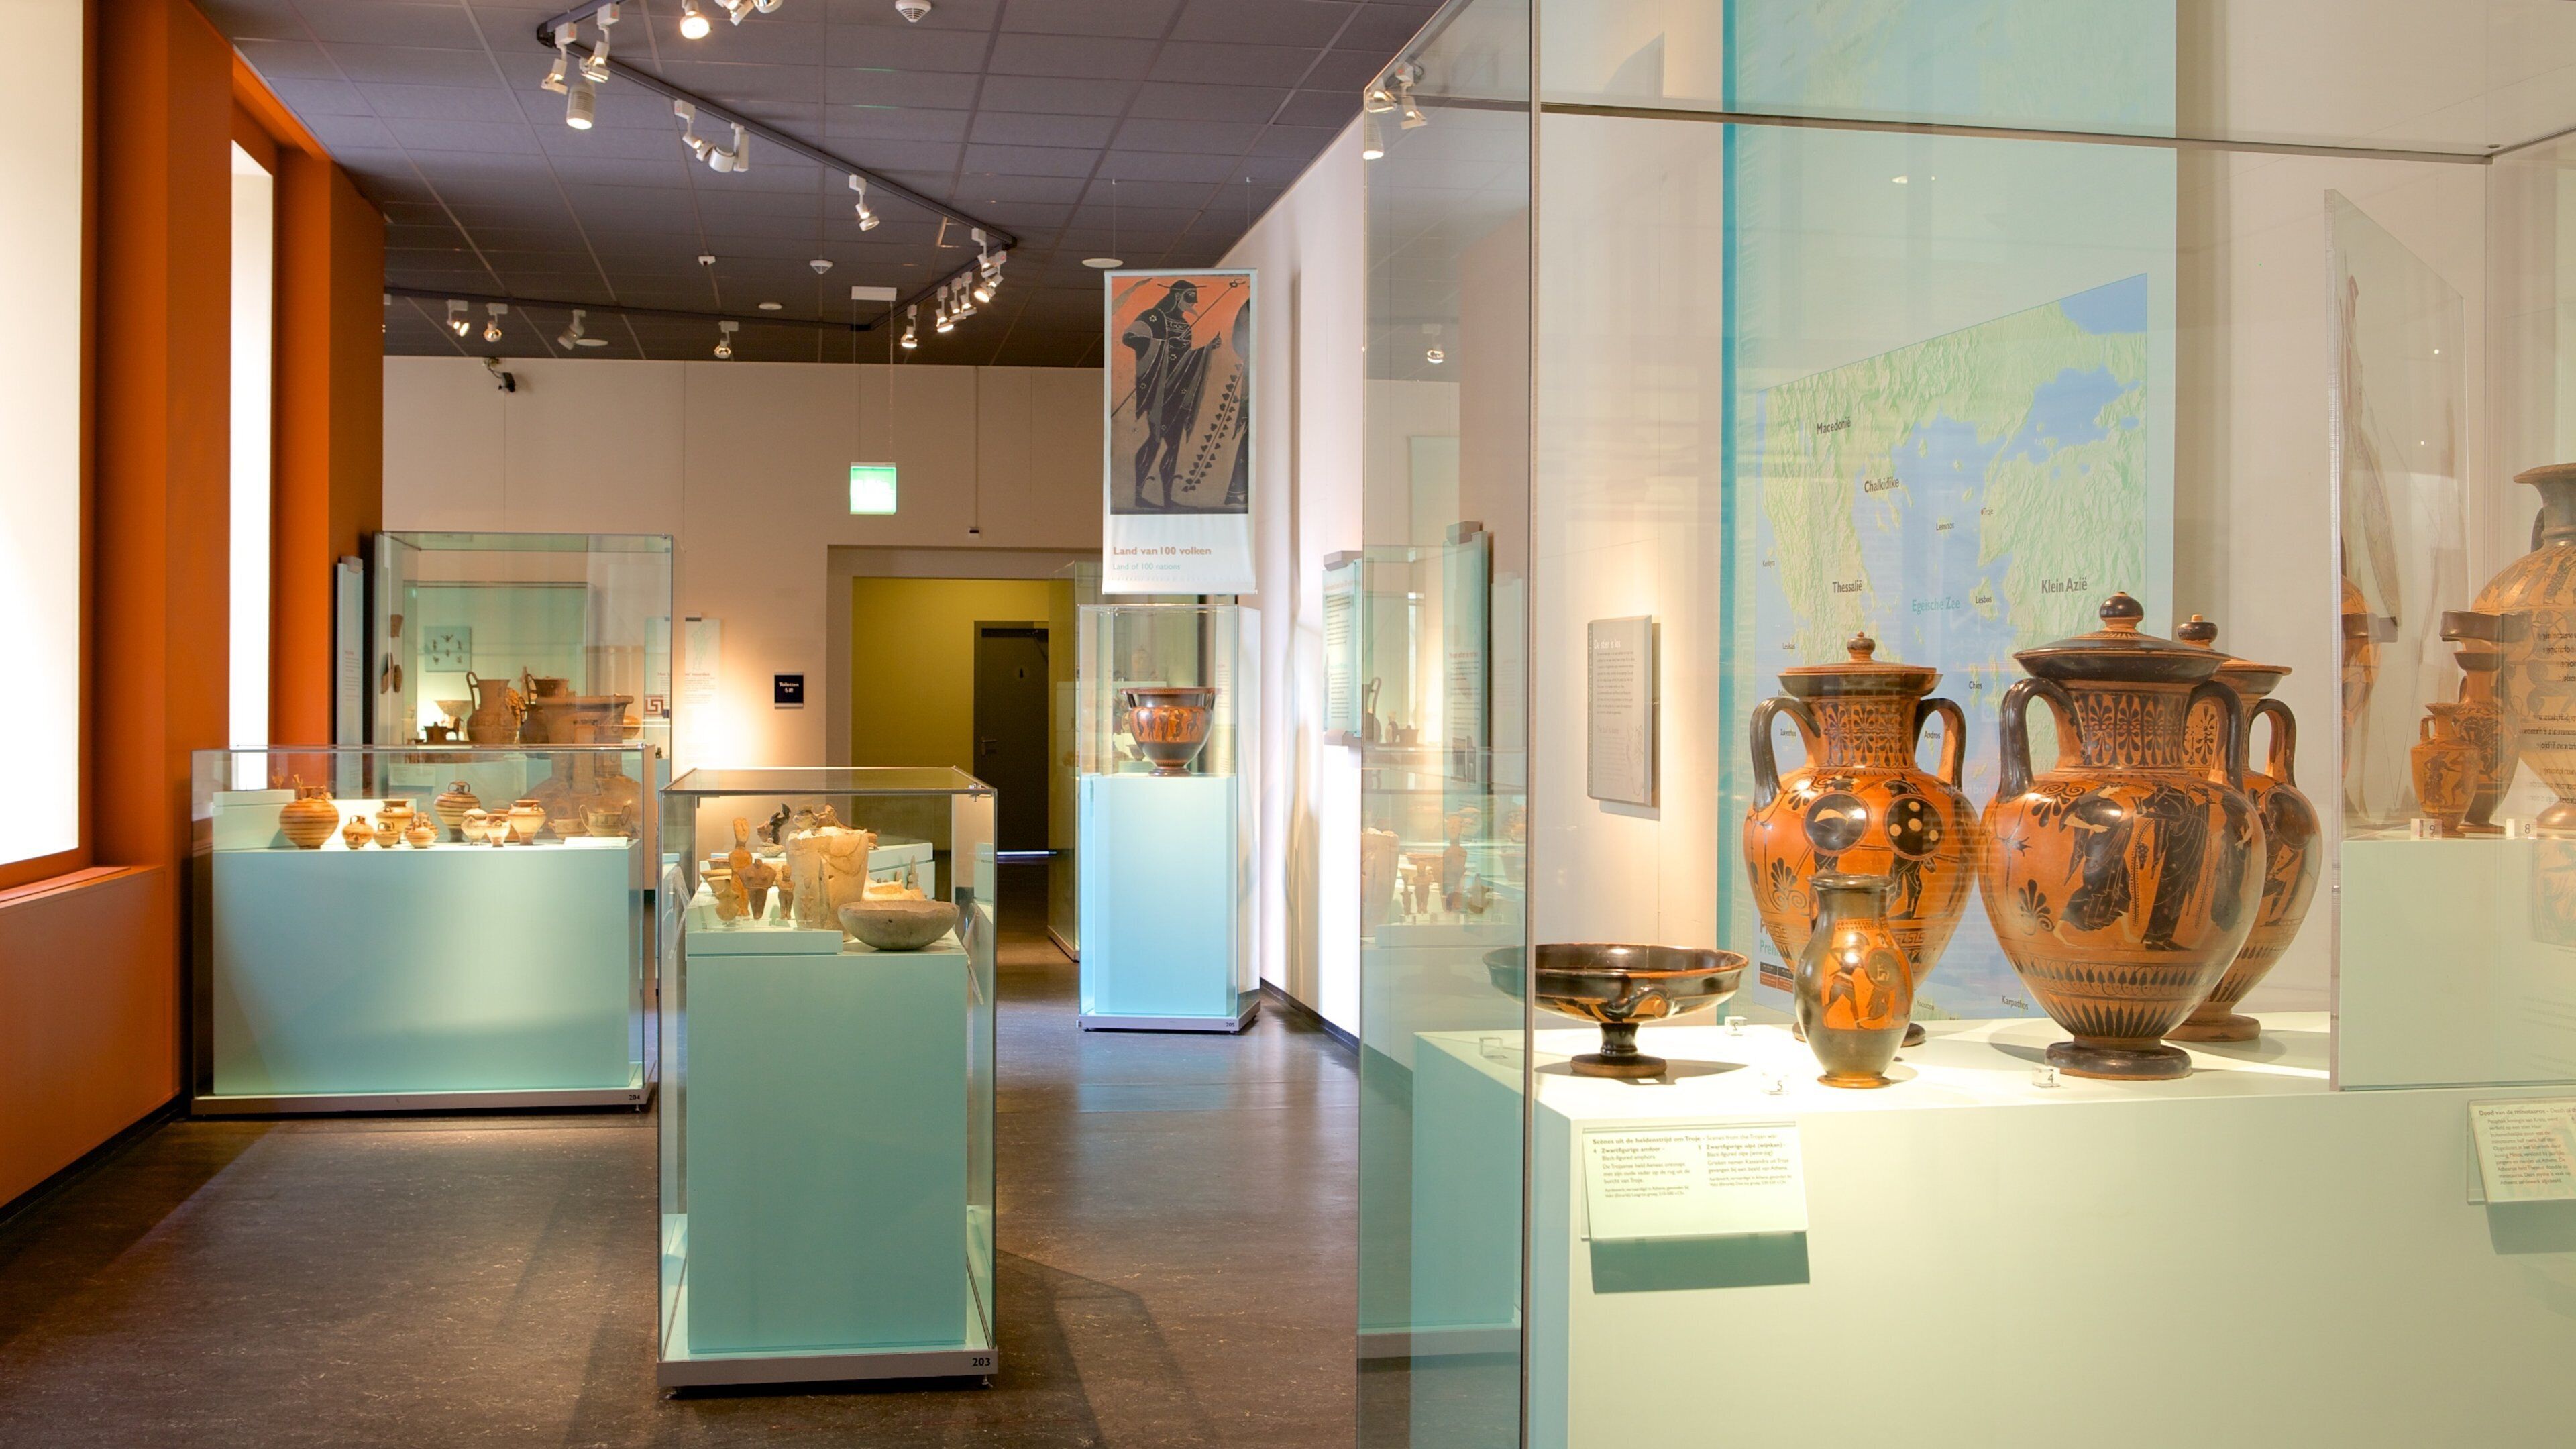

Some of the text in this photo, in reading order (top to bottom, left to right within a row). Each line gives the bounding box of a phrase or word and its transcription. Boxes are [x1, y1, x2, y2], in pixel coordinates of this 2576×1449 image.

[1817, 416, 1851, 435] Macedonië
[1864, 476, 1899, 493] Chalkidike
[1936, 523, 1954, 531] Lemnos
[1114, 546, 1138, 555] Land
[1160, 546, 1177, 555] 100
[1179, 546, 1212, 555] volken
[1833, 580, 1862, 593] Thessalië
[2041, 577, 2087, 593] Klein Azië
[1913, 596, 1960, 614] Egeïsche Zee
[1976, 596, 1992, 604] Lesbos
[1969, 681, 1982, 689] Chios
[2430, 825, 2435, 837] 9
[2525, 824, 2530, 833] 8
[2002, 995, 2028, 1010] Karpathos
[2047, 1075, 2053, 1083] 4
[973, 1358, 990, 1366] 203
